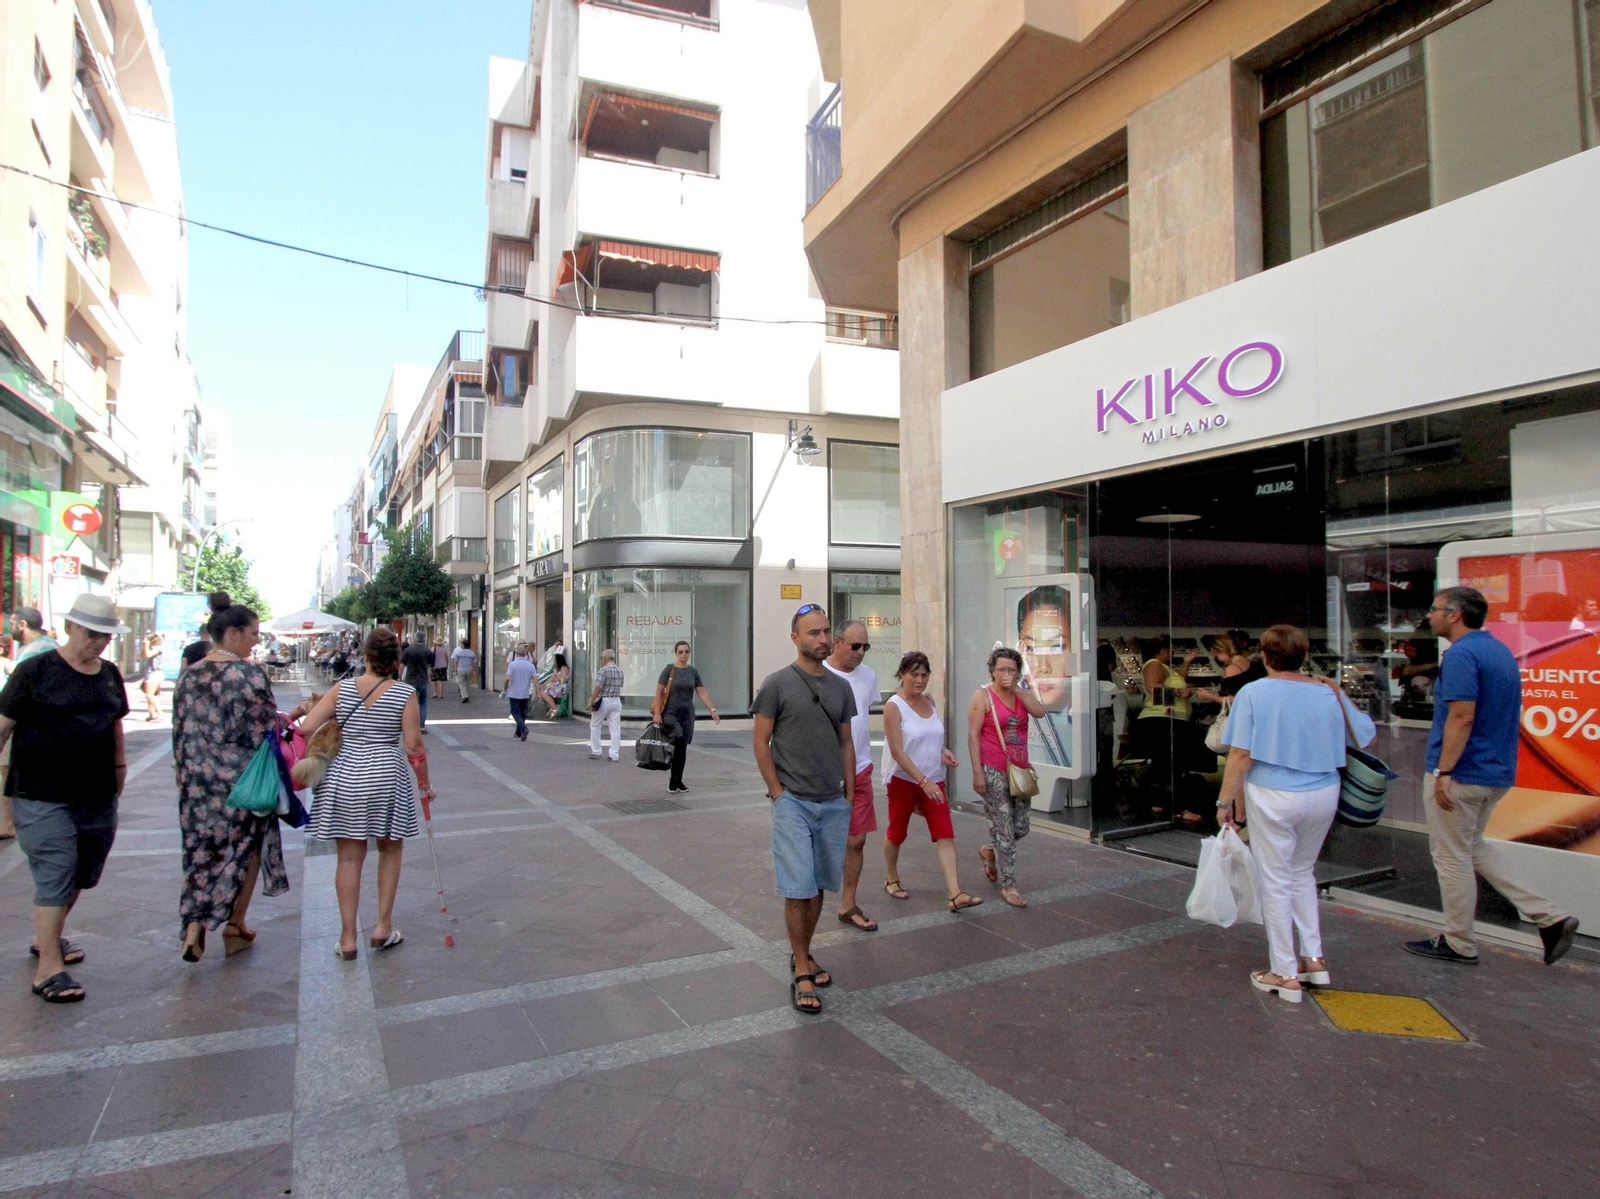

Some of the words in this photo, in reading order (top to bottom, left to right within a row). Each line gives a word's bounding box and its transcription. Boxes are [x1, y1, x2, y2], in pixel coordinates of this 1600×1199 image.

[1097, 342, 1285, 433] KIKO
[1142, 414, 1228, 443] MILANO
[626, 615, 683, 626] REBAJAS
[1562, 690, 1579, 699] EL
[1520, 705, 1600, 740] 0%
